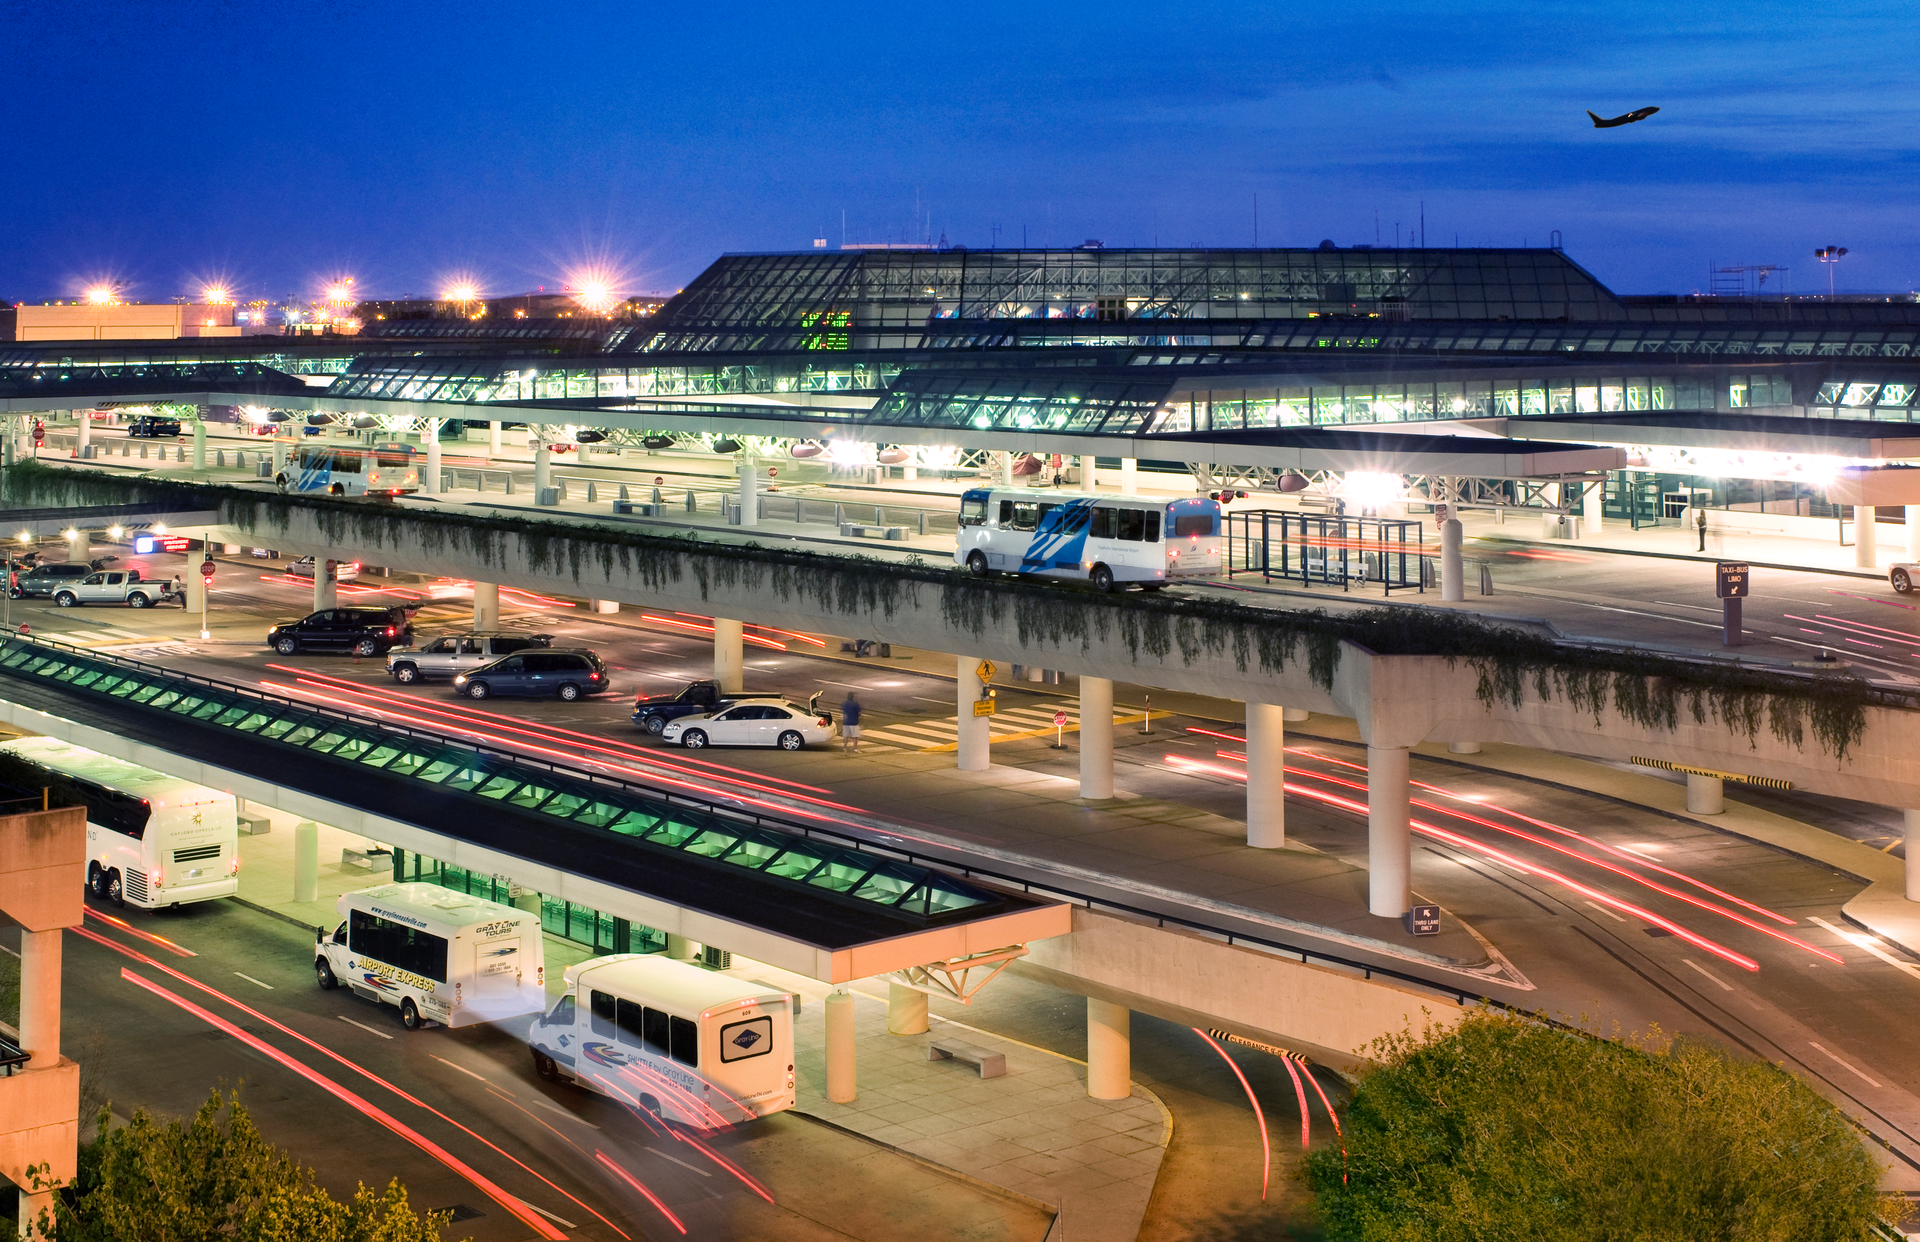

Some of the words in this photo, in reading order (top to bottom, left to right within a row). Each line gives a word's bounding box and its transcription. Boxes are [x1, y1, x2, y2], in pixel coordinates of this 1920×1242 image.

[201, 565, 215, 573] STOP
[170, 829, 194, 837] GAYLORD
[371, 906, 427, 929] www.graylinenashville.com
[476, 923, 500, 933] GRAY
[501, 920, 521, 929] LINE
[485, 927, 512, 937] TOURS
[357, 956, 395, 979] AIRPORT
[395, 968, 436, 993] EXPRESS
[734, 1036, 748, 1044] Gray
[748, 1034, 760, 1042] Line
[1230, 1036, 1269, 1052] CLEARANCE
[627, 1053, 652, 1070] SHUTTLE
[653, 1063, 662, 1073] by
[662, 1066, 680, 1080] Gray
[680, 1072, 695, 1086] Line
